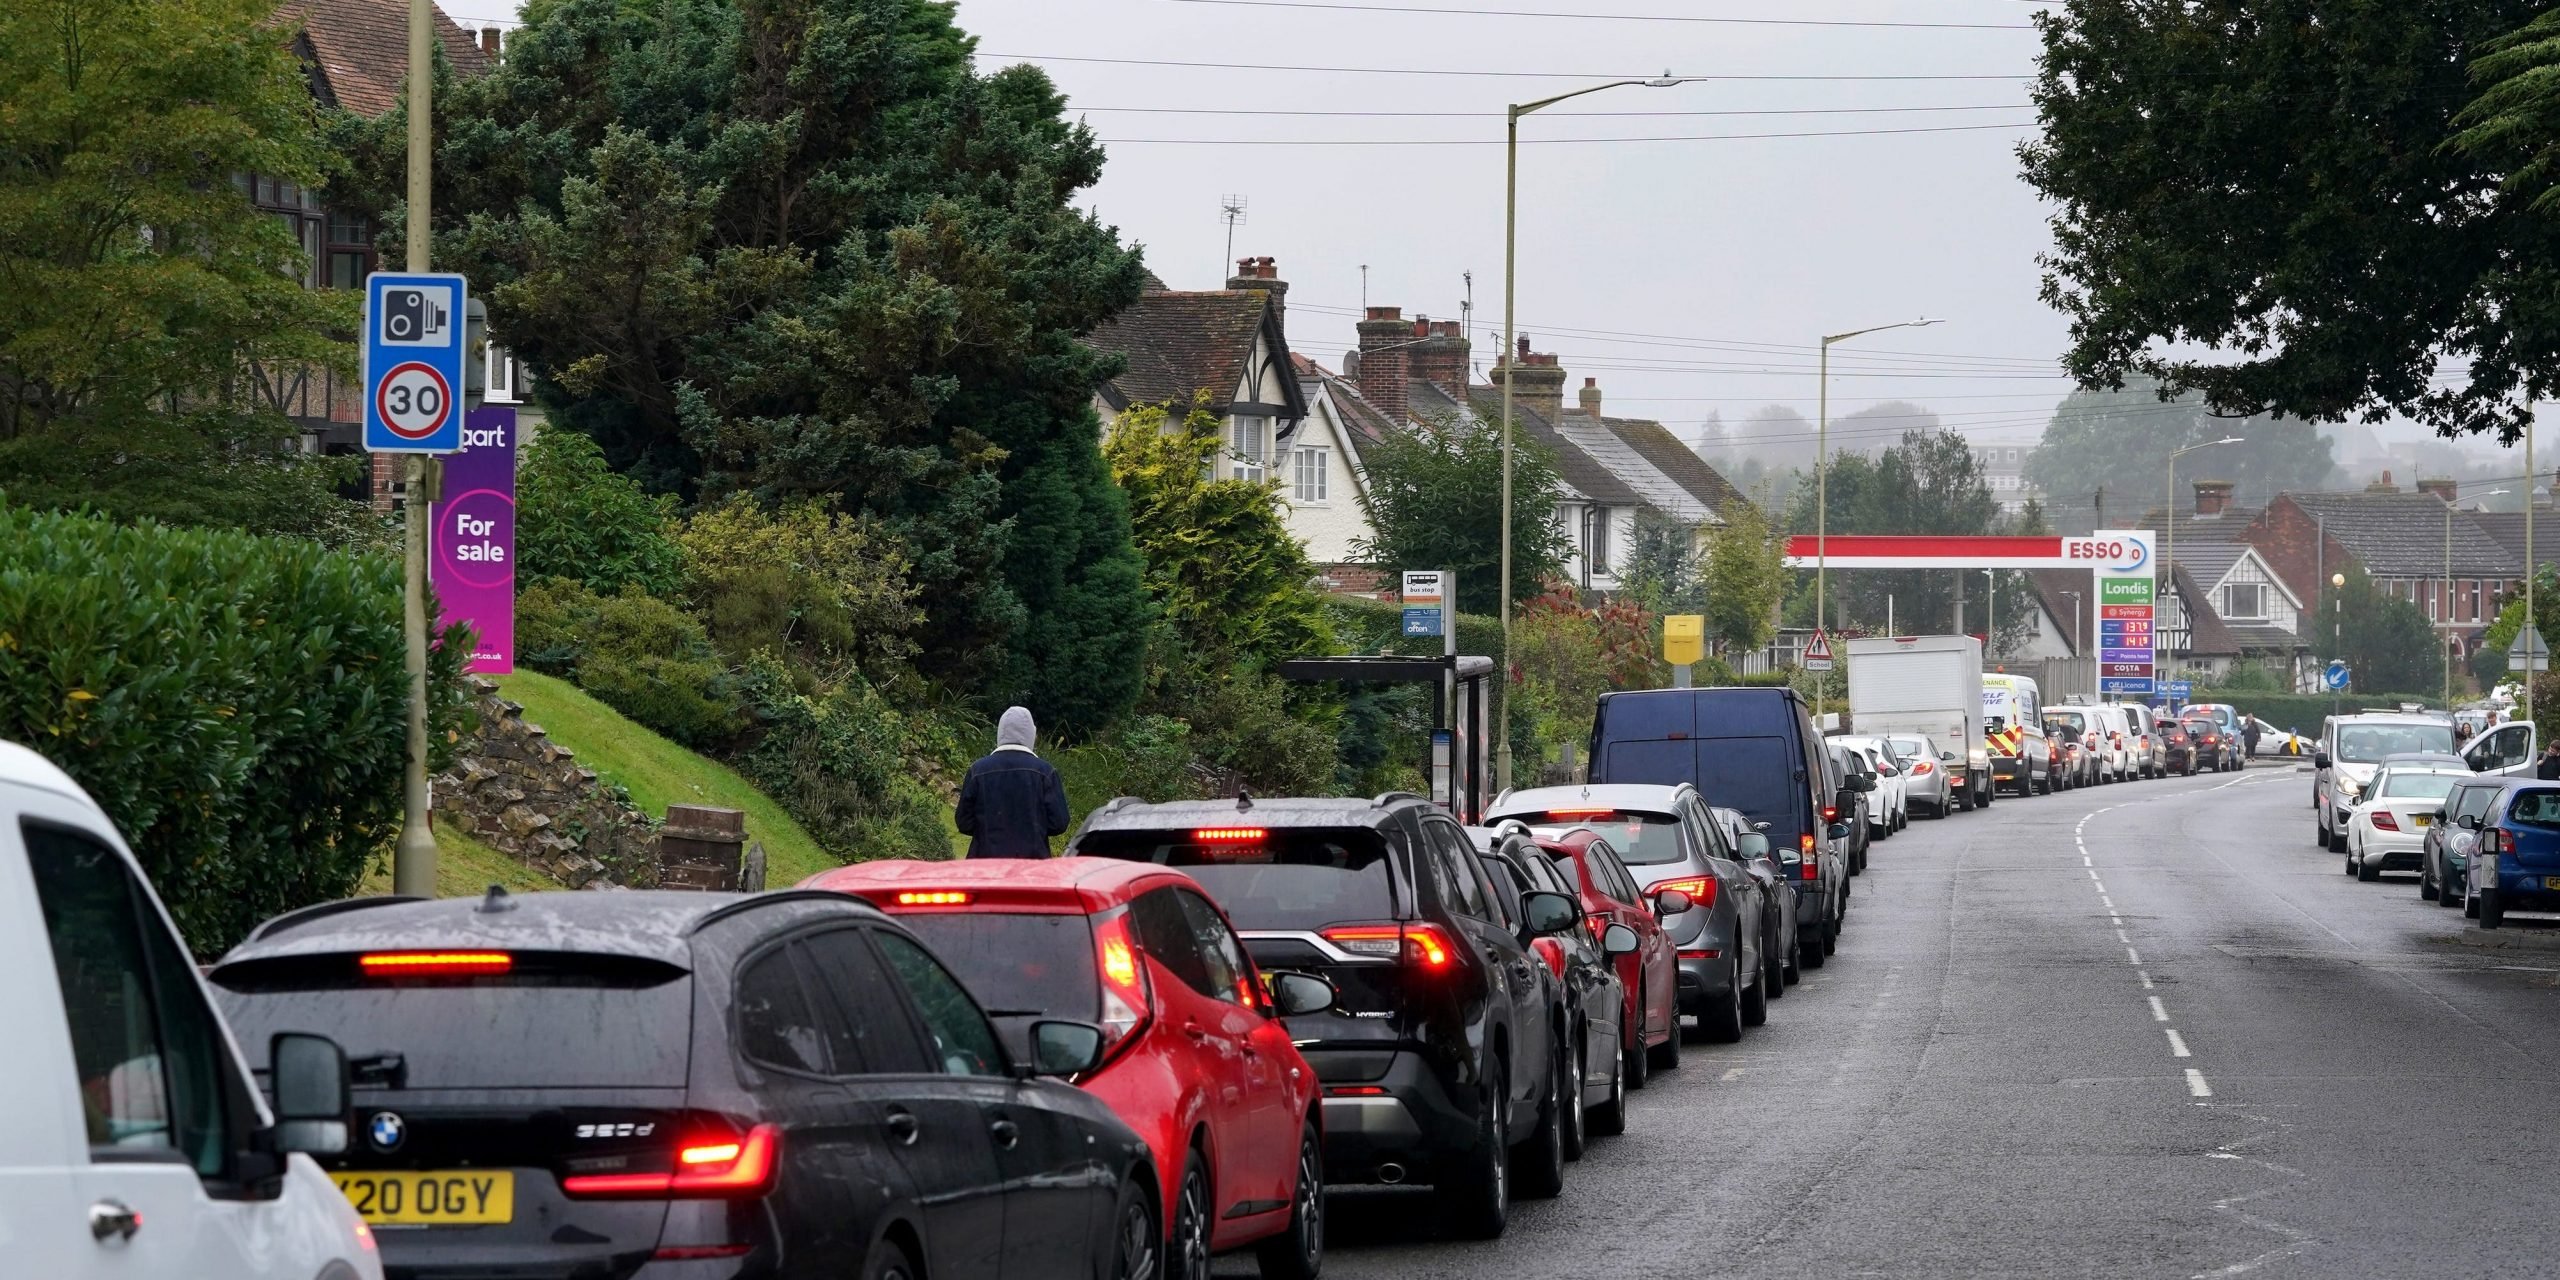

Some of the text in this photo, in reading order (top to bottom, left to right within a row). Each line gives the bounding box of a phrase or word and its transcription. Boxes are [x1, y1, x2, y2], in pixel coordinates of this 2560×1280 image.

[389, 385, 440, 416] 30
[457, 513, 495, 536] For
[456, 539, 505, 562] sale
[2069, 541, 2123, 559] ESSO
[2105, 582, 2149, 595] Londis
[2119, 608, 2146, 618] Synergy
[2114, 664, 2140, 672] COSTA
[416, 1178, 494, 1215] OGY
